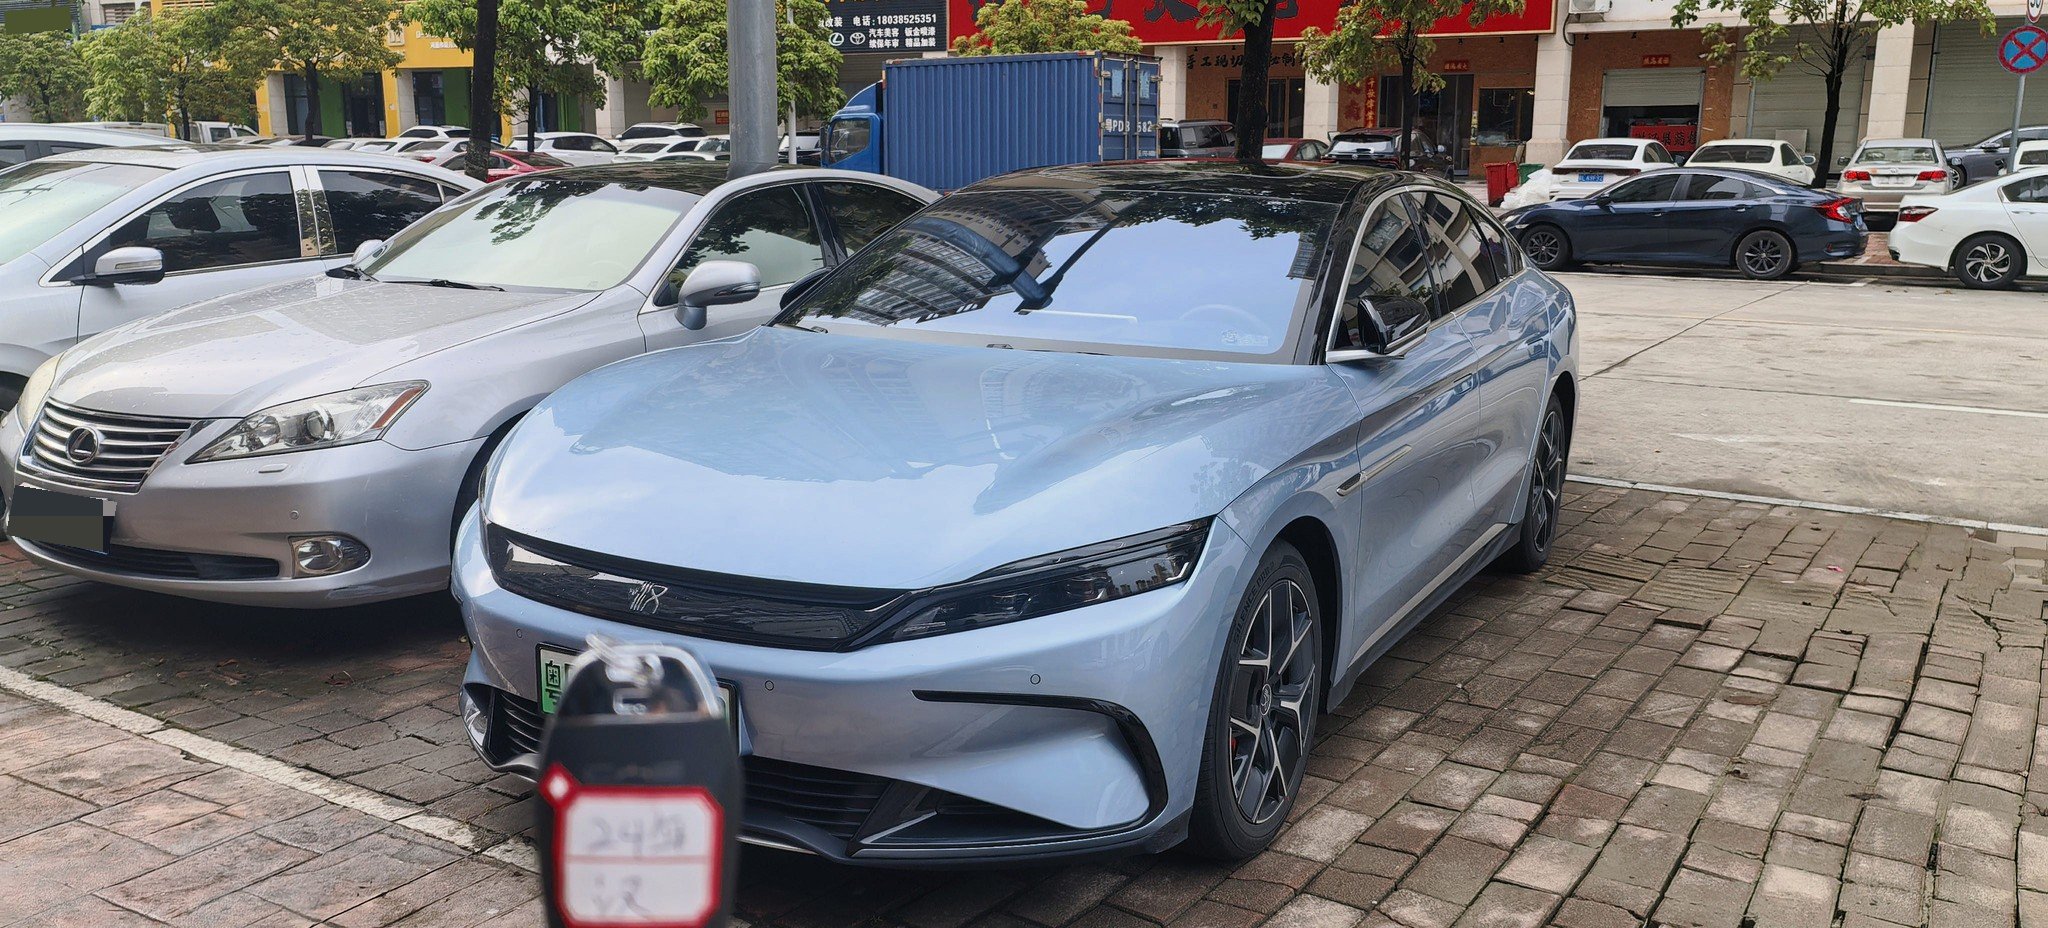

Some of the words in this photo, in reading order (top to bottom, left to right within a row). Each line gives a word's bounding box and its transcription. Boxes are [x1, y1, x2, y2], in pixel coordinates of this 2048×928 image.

[869, 28, 899, 38] 汽车美容
[905, 27, 936, 37] 钣金喷漆
